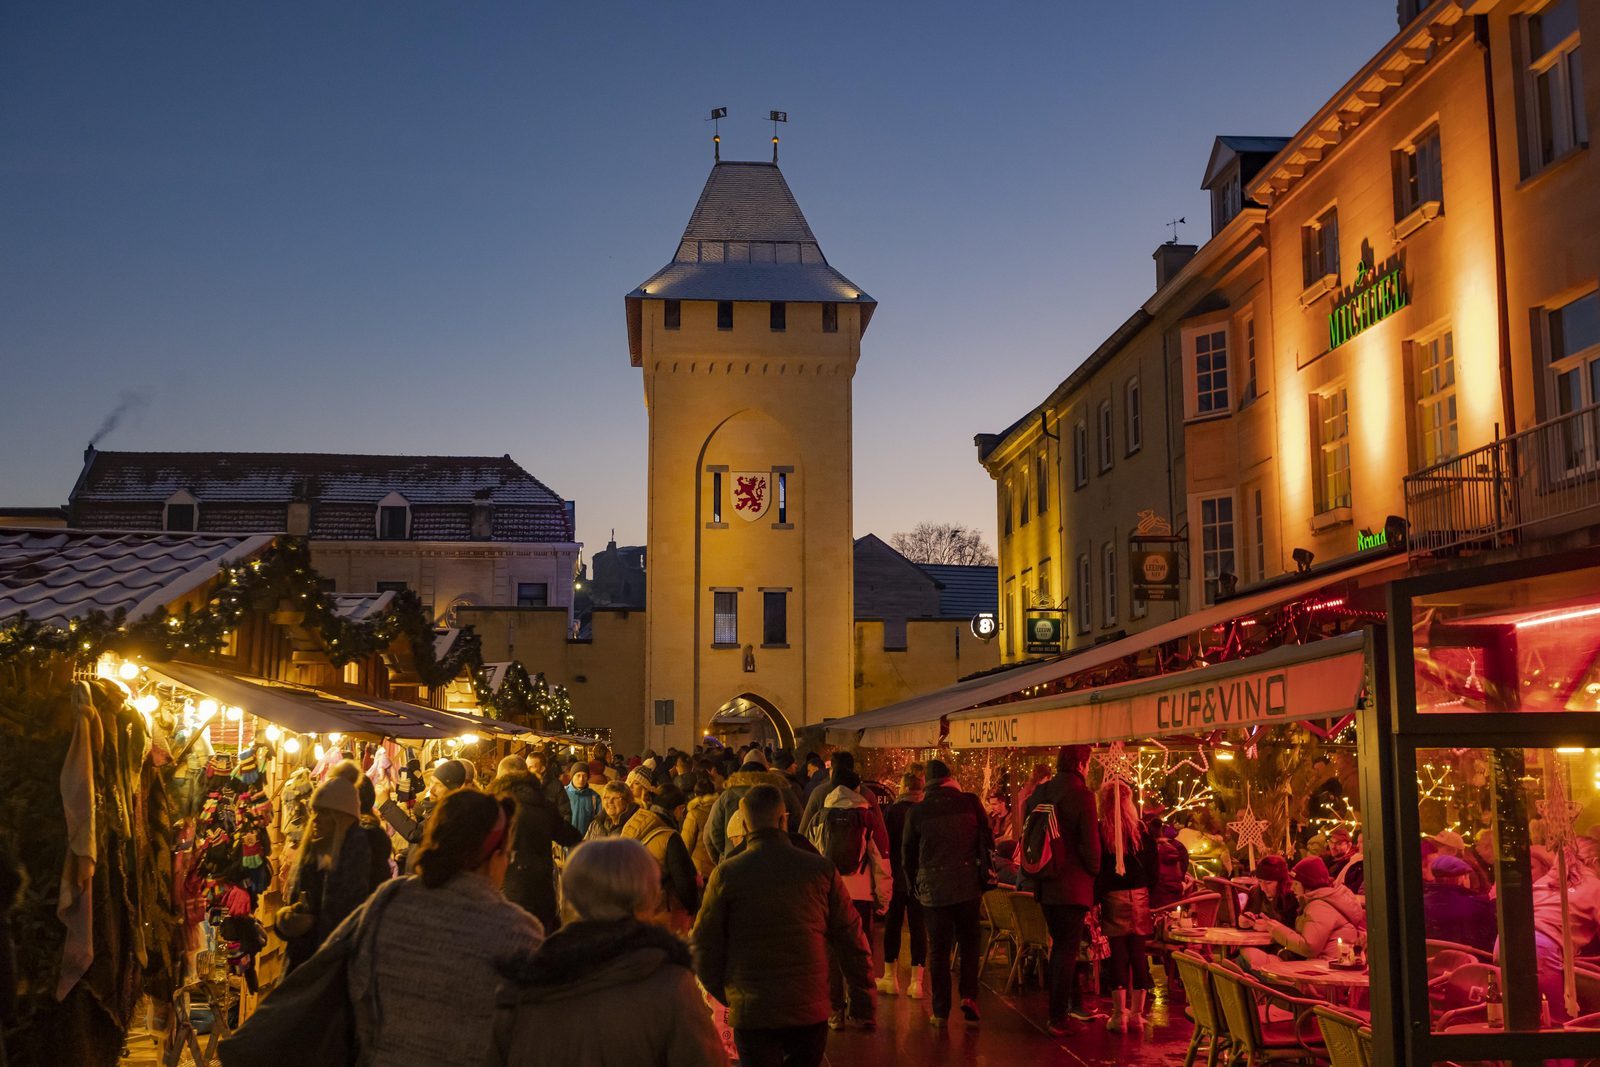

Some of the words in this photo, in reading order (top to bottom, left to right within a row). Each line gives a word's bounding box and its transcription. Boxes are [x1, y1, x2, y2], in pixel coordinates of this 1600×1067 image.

[1328, 269, 1406, 352] MICHIEL
[978, 618, 991, 634] 8
[1157, 673, 1286, 729] CUP&VINO
